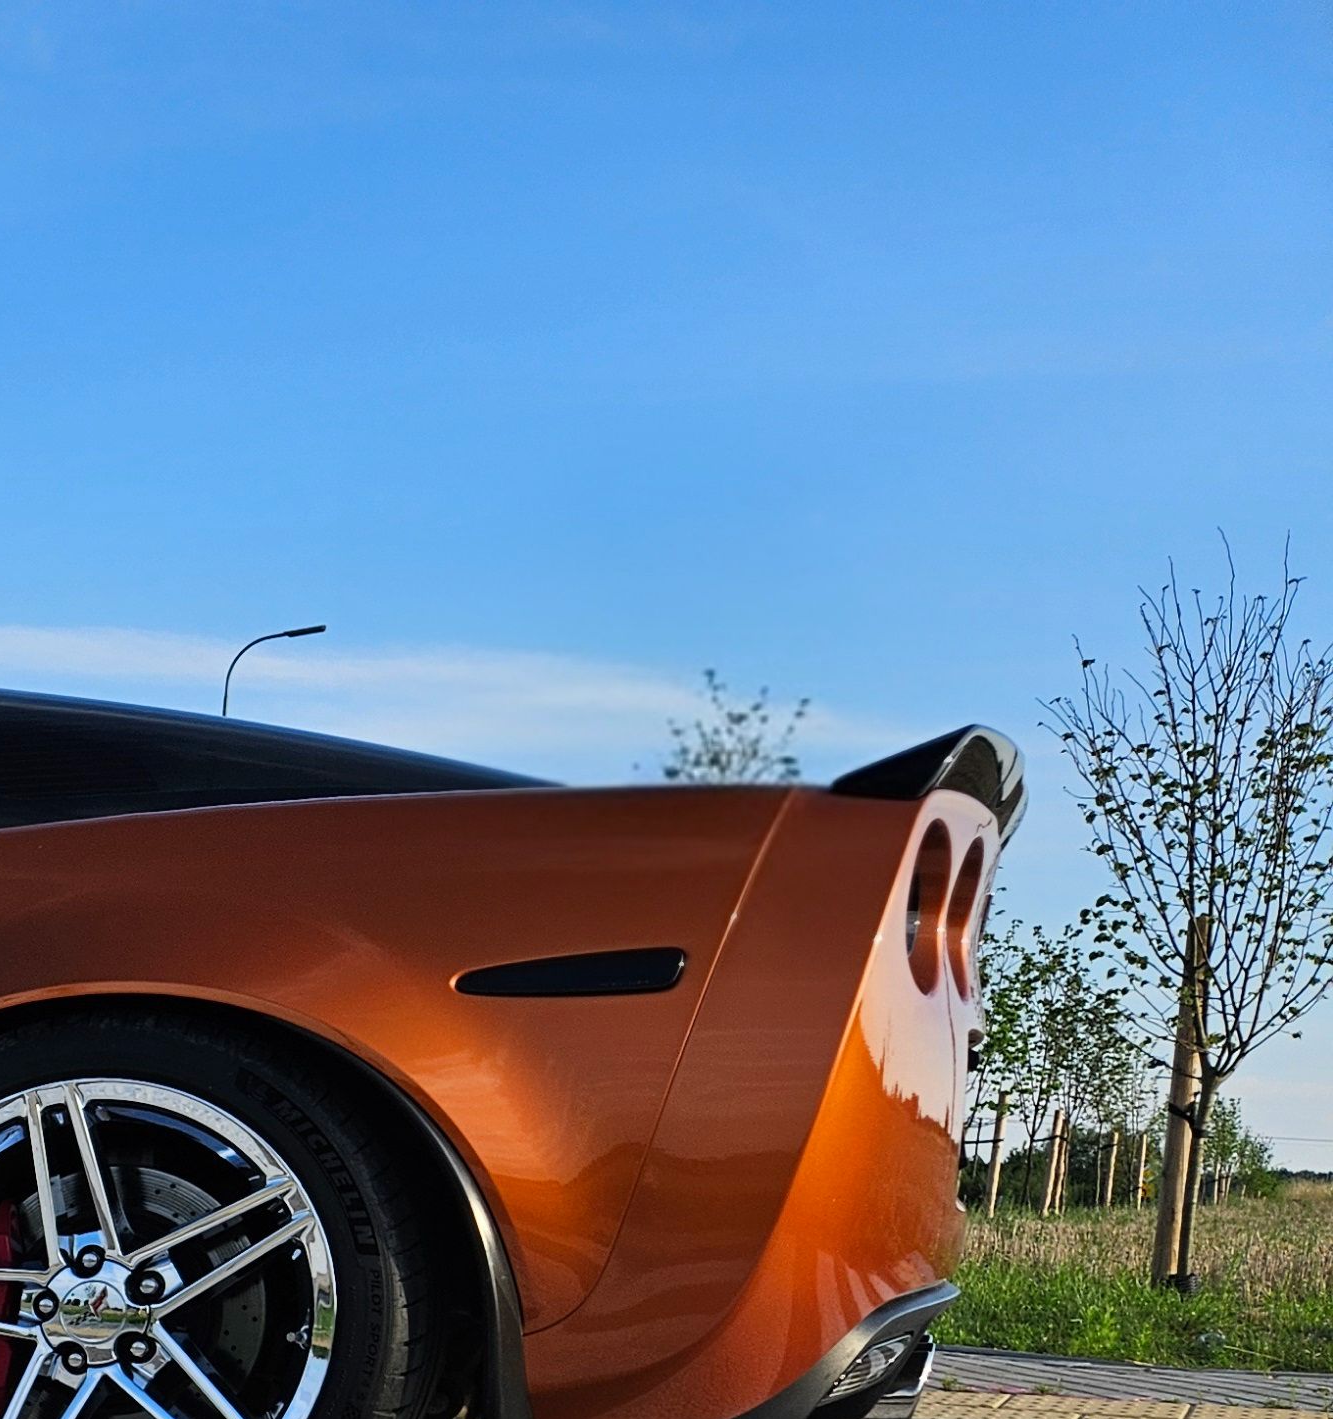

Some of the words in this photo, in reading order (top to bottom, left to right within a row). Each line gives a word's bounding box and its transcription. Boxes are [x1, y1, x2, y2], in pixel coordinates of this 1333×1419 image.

[271, 1099, 377, 1248] MICHELIN
[368, 1269, 382, 1316] PILOT
[360, 1321, 381, 1377] SPORT
